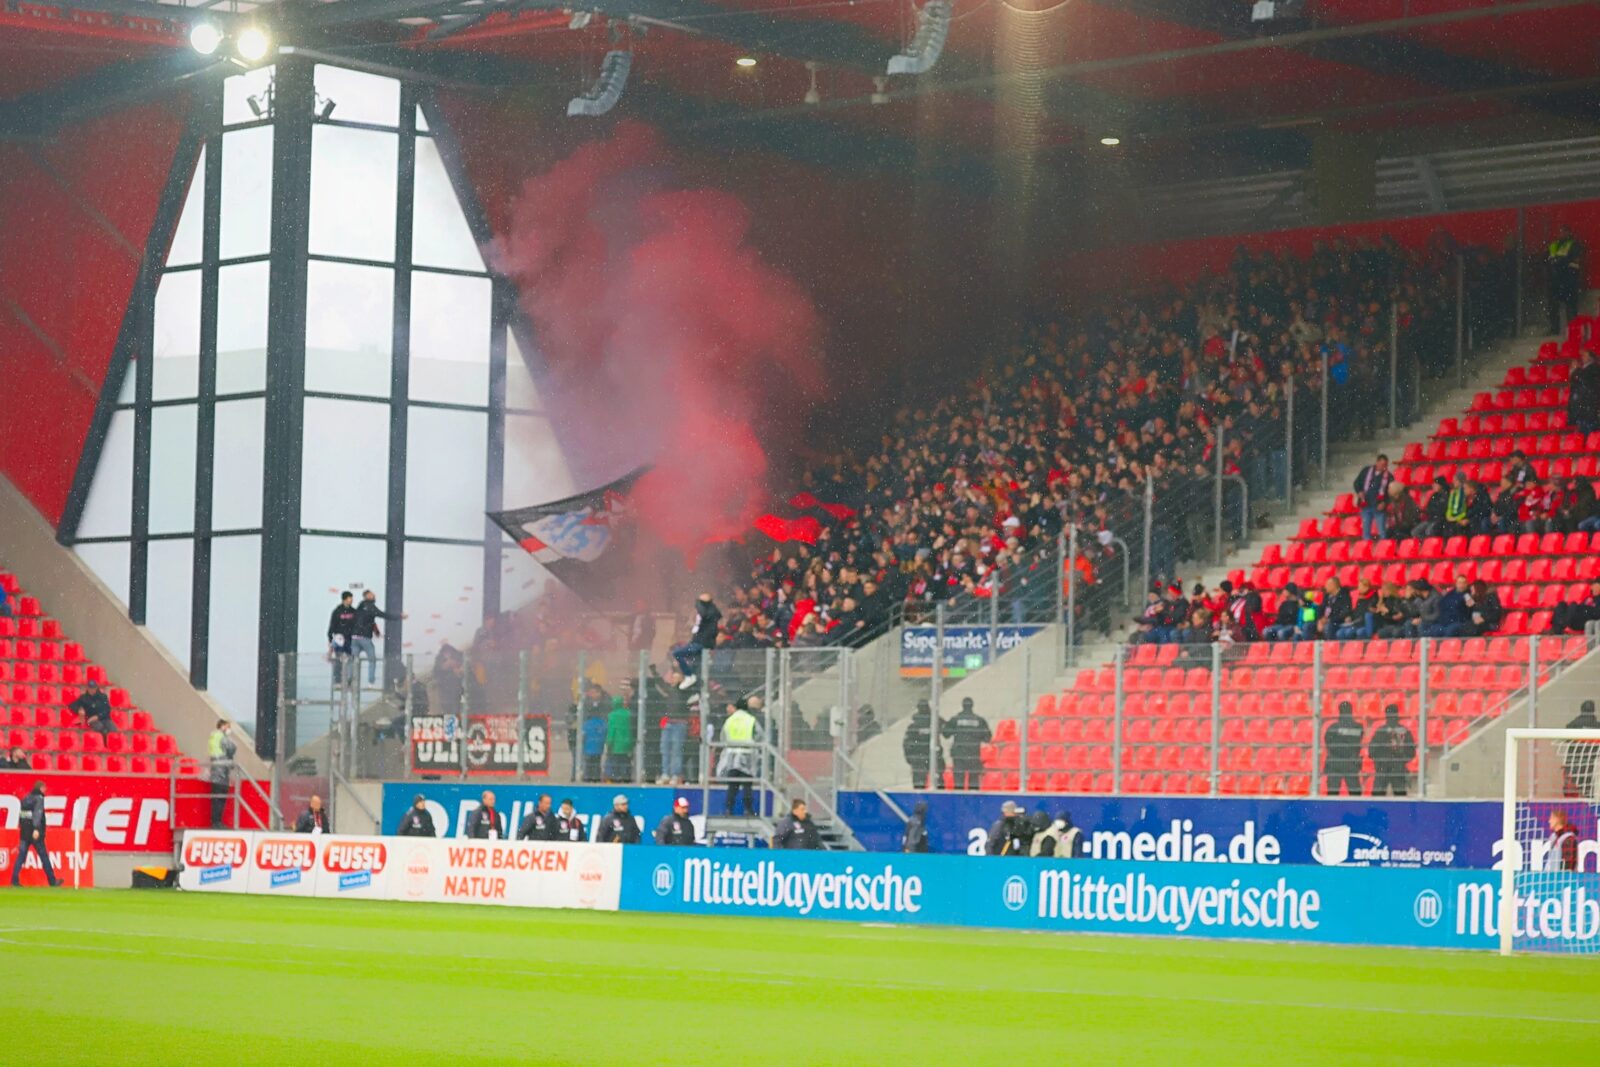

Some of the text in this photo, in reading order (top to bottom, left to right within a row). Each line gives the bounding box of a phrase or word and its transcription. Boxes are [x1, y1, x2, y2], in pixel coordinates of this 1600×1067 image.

[65, 851, 90, 870] TV
[190, 841, 242, 864] FUSSL
[260, 844, 313, 867] FUSSL
[328, 847, 382, 870] FUSSL
[449, 847, 568, 871] WIR BACKEN
[1354, 846, 1389, 860] andré
[444, 876, 506, 898] NATUR
[683, 858, 922, 914] Mittelbayerische
[1038, 869, 1320, 931] Mittelbayerische
